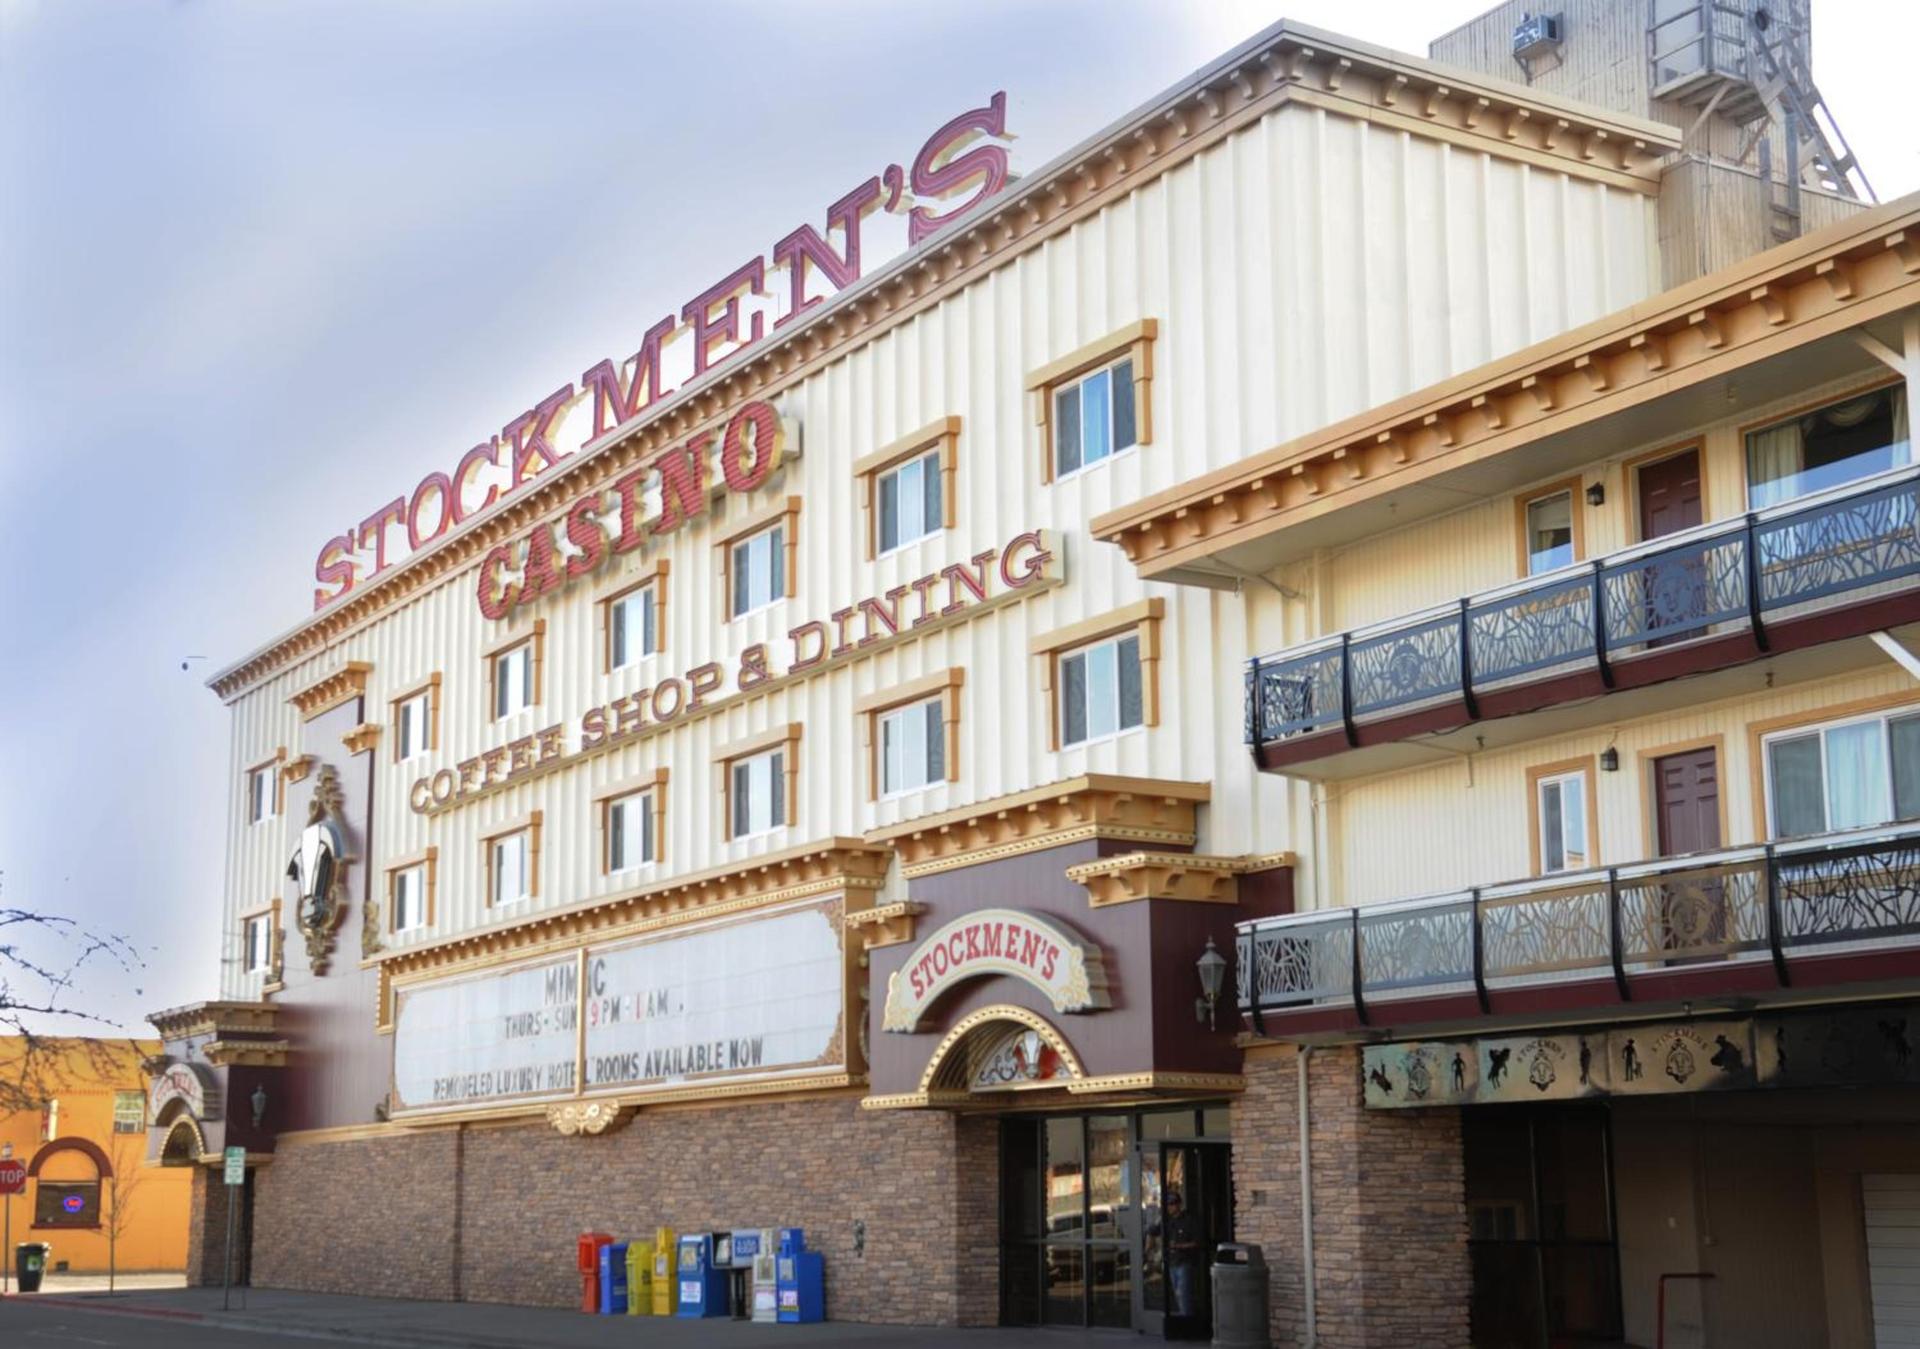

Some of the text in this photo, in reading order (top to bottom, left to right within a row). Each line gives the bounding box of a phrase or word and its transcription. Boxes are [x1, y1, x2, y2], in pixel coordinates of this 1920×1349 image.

[313, 89, 1012, 611] STOCKMEN'S
[477, 400, 784, 621] CASINO
[410, 529, 1055, 815] COFFEE SHOP & DINING
[909, 922, 1060, 1000] STOCKMEN'S
[496, 1065, 542, 1094] LUXURY
[596, 1052, 639, 1082] ROOMS
[644, 1041, 723, 1077] AVAILABLE
[729, 1035, 764, 1068] NOW
[0, 1169, 25, 1184] TOP
